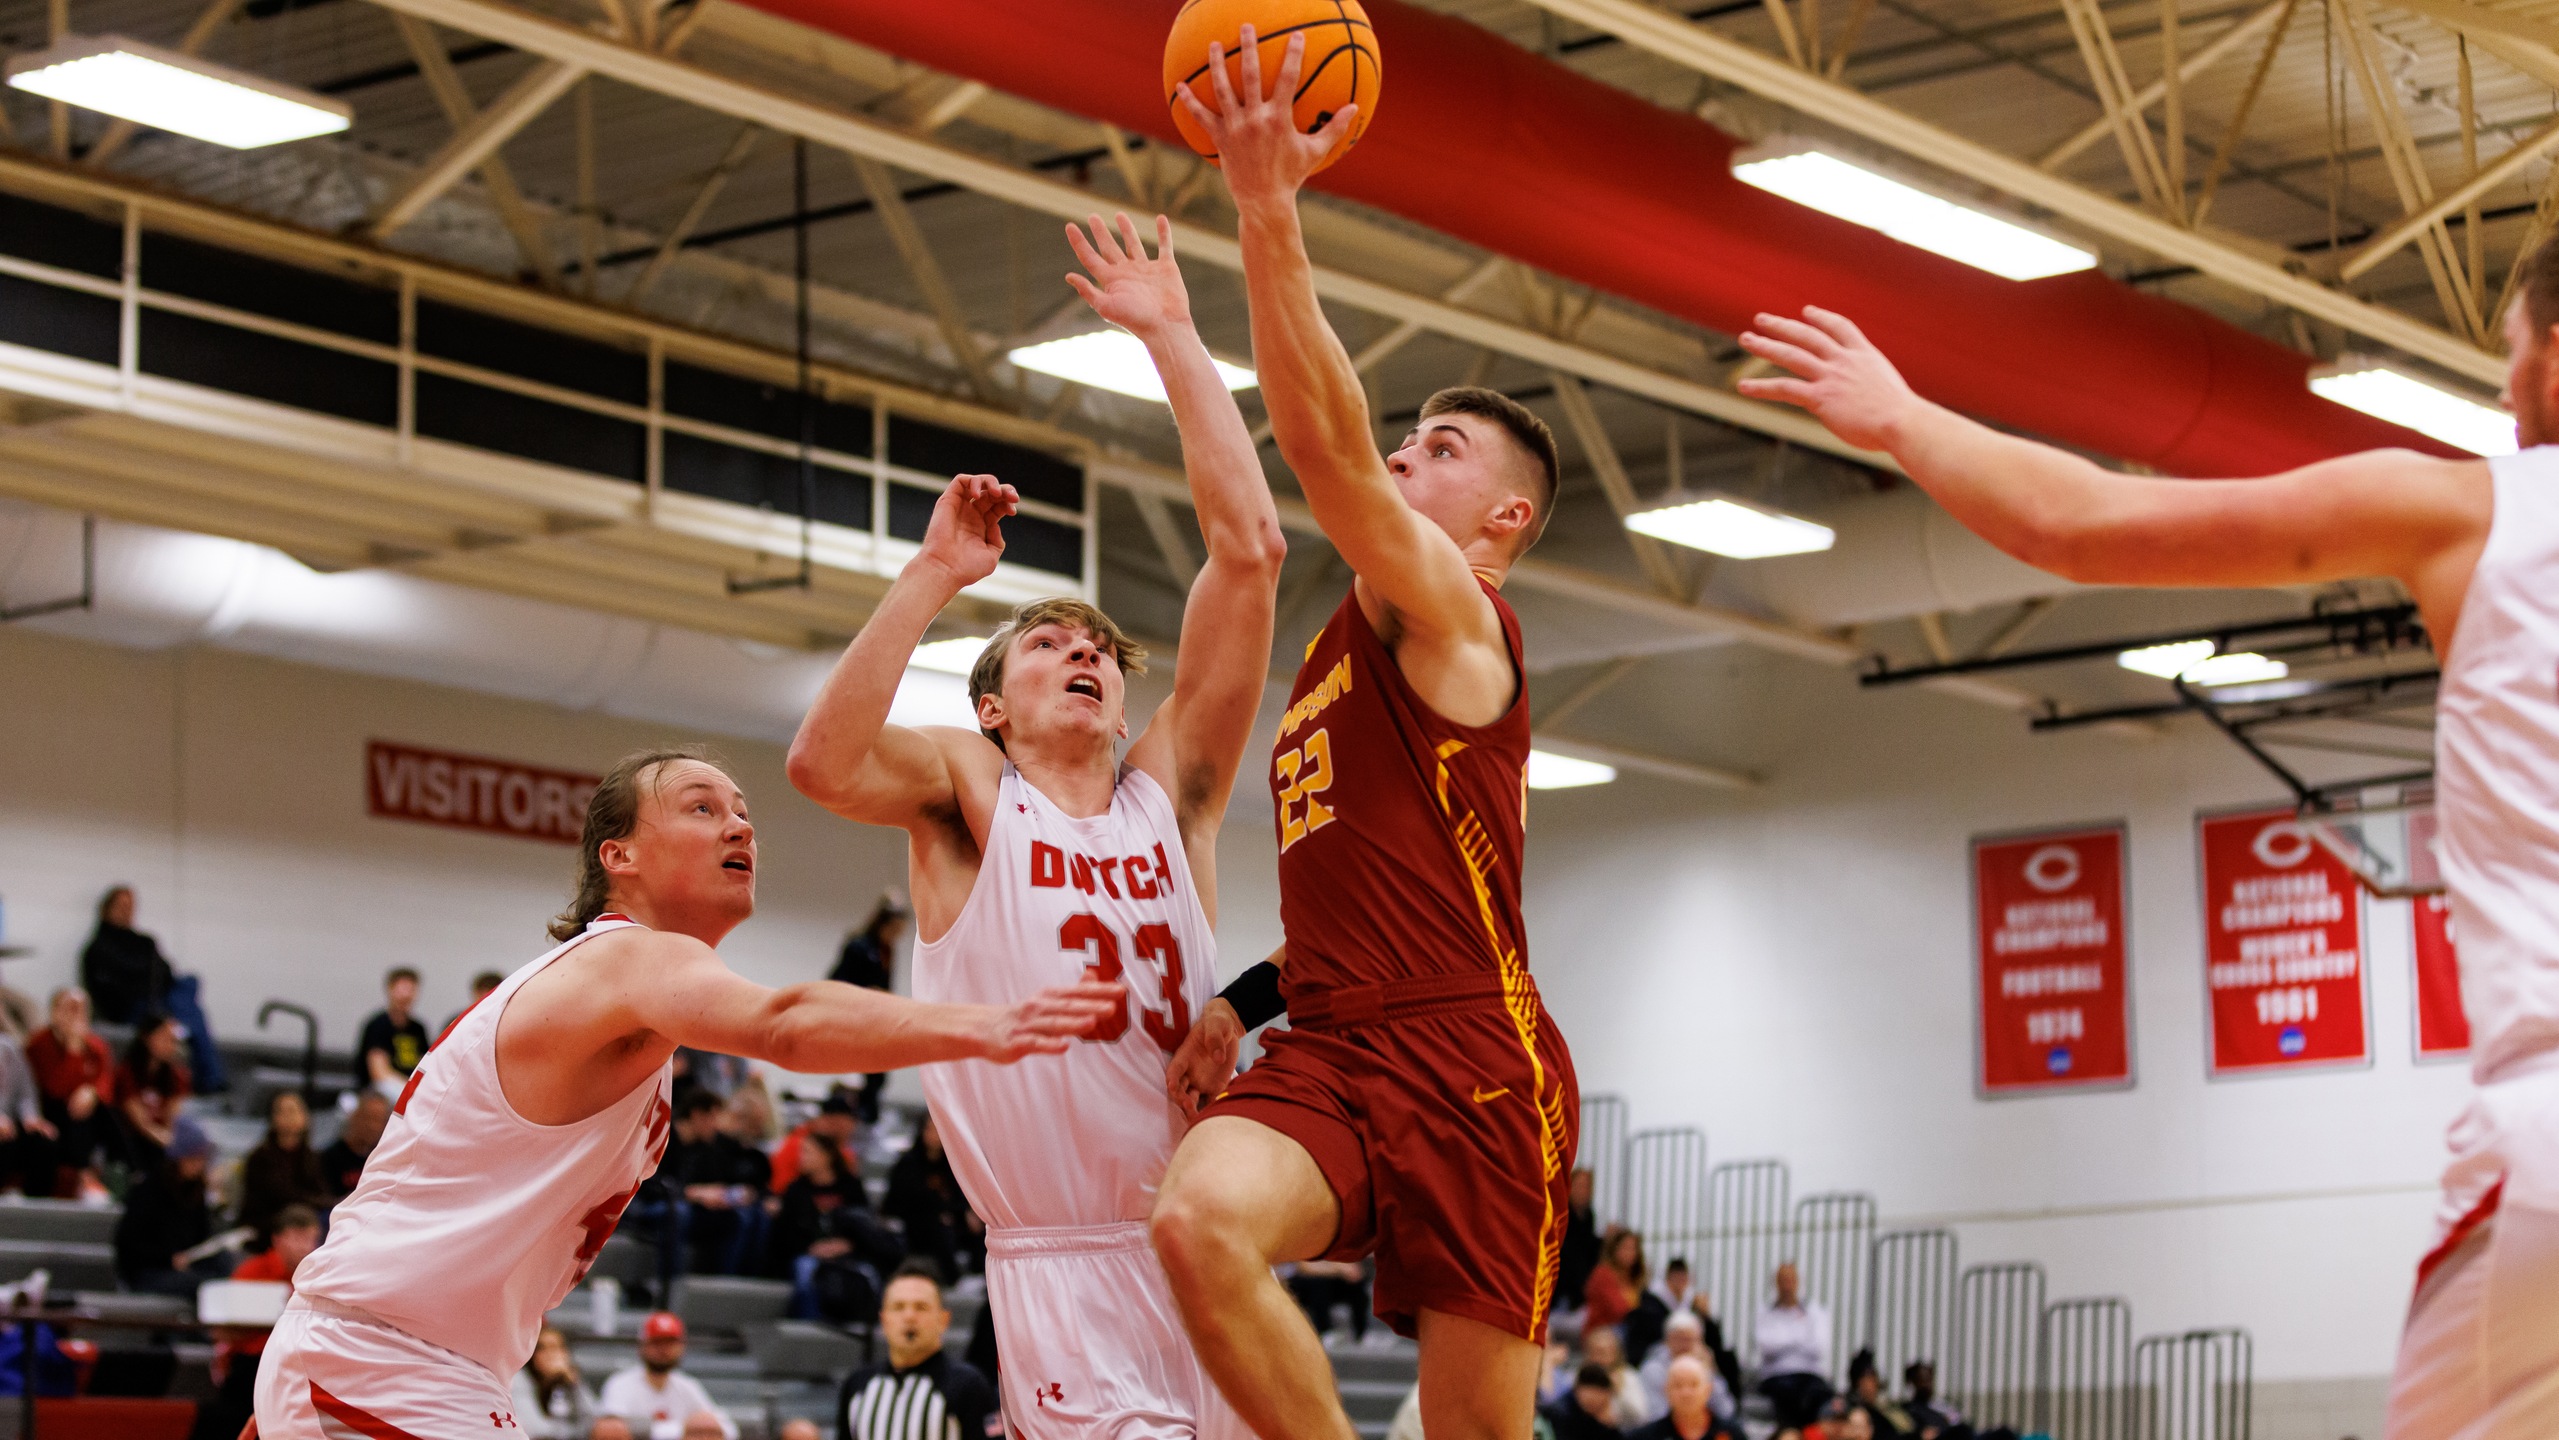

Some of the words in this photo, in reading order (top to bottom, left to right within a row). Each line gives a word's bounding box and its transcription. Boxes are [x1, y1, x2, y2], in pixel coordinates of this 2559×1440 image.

[375, 752, 598, 832] VISITORS
[1276, 728, 1337, 855] 22
[1030, 838, 1176, 901] DUTCH
[2232, 871, 2329, 904] NATIONAL
[2005, 896, 2096, 928] NATIONAL
[2221, 893, 2343, 932] CHAMPIONS
[1993, 918, 2108, 955] CHAMPIONS
[2239, 929, 2328, 962] WOMEN'S
[1056, 911, 1191, 1056] 33
[2002, 963, 2103, 998] FOOTBALL
[2210, 961, 2273, 989] CROSS
[2274, 950, 2357, 984] COUNTRY
